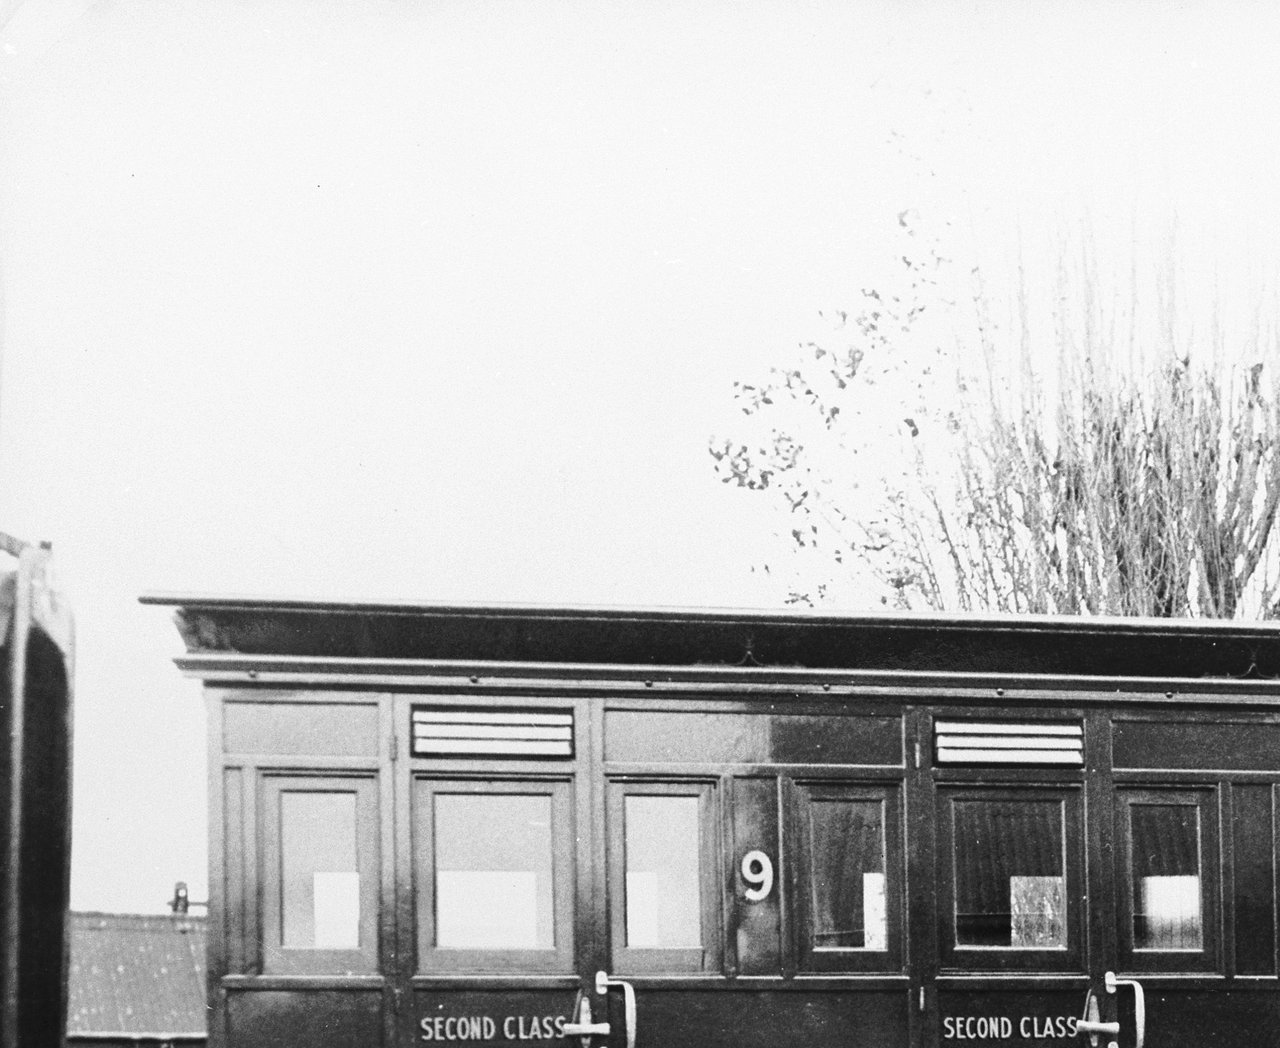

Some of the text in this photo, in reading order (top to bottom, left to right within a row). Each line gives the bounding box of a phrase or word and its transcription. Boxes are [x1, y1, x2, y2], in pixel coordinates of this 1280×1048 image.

[741, 850, 774, 901] 9
[420, 1015, 567, 1041] SECOND CLASS
[943, 1015, 1078, 1039] SECOND CLASS
